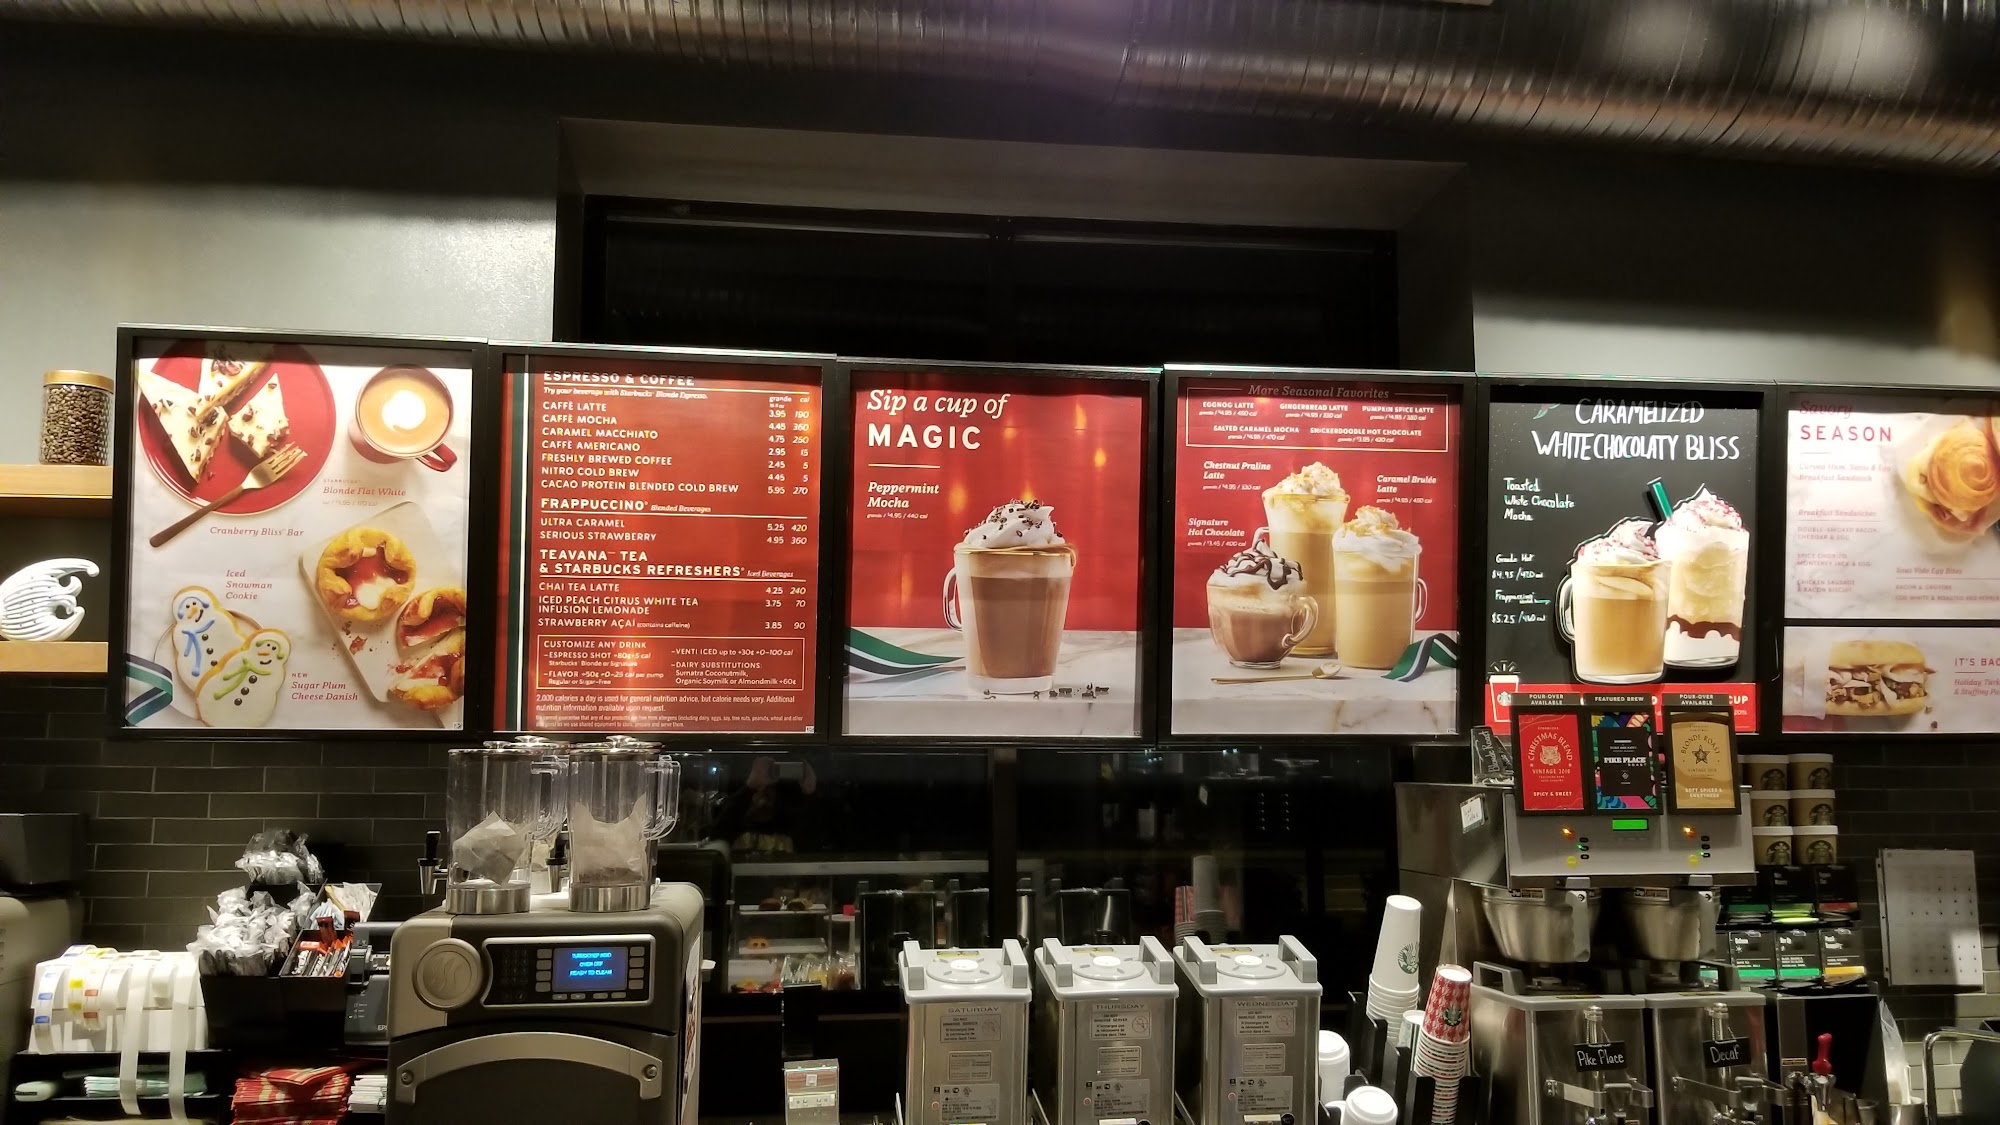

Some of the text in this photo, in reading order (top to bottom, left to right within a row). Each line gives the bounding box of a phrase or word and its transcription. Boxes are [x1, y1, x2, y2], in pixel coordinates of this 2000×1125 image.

[544, 371, 695, 386] ESPRESSO & COFFEE
[1248, 385, 1390, 399] More Seasonal Favorites
[542, 401, 607, 412] CAFFÈ LATTE
[867, 389, 1011, 419] Sip a cup of
[769, 410, 786, 418] 3.95
[1575, 398, 1705, 424] CARAMELIZED
[542, 414, 618, 424] CAFFÈ MOCHA
[768, 422, 786, 430] 4.45
[542, 428, 658, 439] CARAMEL MACCHIATO
[868, 423, 981, 450] MAGIC
[1800, 425, 1892, 441] SEASON
[768, 436, 809, 444] 4.75 250
[542, 440, 640, 452] CAFFÈ AMERICANO
[1531, 430, 1740, 461] WHITECHOCOLATY BLISS
[542, 453, 672, 466] FRESHLY BREWED COFFEE
[1203, 460, 1271, 471] Chestnut Praline
[542, 467, 640, 477] NITRO COLD BREW
[1203, 472, 1225, 480] Latte
[1376, 475, 1410, 484] Caramel
[1503, 477, 1540, 492] Toasted
[322, 486, 355, 496] Blonde
[378, 488, 406, 496] White
[541, 480, 739, 492] CACAO PROTEIN BLENDED COLD BREW
[768, 486, 808, 495] 5.95 270
[868, 482, 940, 495] Peppermint
[1376, 485, 1398, 493] Latte
[866, 496, 910, 508] Mocha
[1531, 492, 1575, 508] Chocolate
[1504, 508, 1534, 521] Mocha
[540, 518, 626, 528] ULTRA CARAMEL
[767, 524, 785, 532] 5.25
[1188, 518, 1229, 528] Signature
[210, 526, 259, 538] Cranberry
[287, 528, 304, 537] Bar
[540, 531, 656, 541] SERIOUS STRAWBERRY
[1188, 528, 1245, 538] Hot Chocolate
[540, 549, 648, 562] TEAVANA TEA
[539, 562, 548, 574] &
[554, 563, 641, 575] STARBUCKS
[226, 570, 246, 578] Iced
[226, 580, 273, 590] Snowman
[538, 582, 620, 592] CHAI TEA LATTE
[766, 586, 806, 595] 4.25 240
[226, 592, 258, 600] Cookie
[538, 596, 699, 606] ICED PEACH CITRUS WHITE TEA
[538, 605, 650, 615] INFUSION LEMONADE
[544, 640, 596, 648] CUSTOMIZE
[1954, 658, 1975, 666] IT'S
[291, 682, 346, 691] Sugar Plum
[291, 692, 358, 701] Cheese Danish
[1528, 732, 1572, 760] CHRISTMAS BLEND
[1680, 734, 1702, 754] BLONDE
[1576, 1048, 1624, 1067] Pike Place
[1710, 1044, 1740, 1064] Decaf
